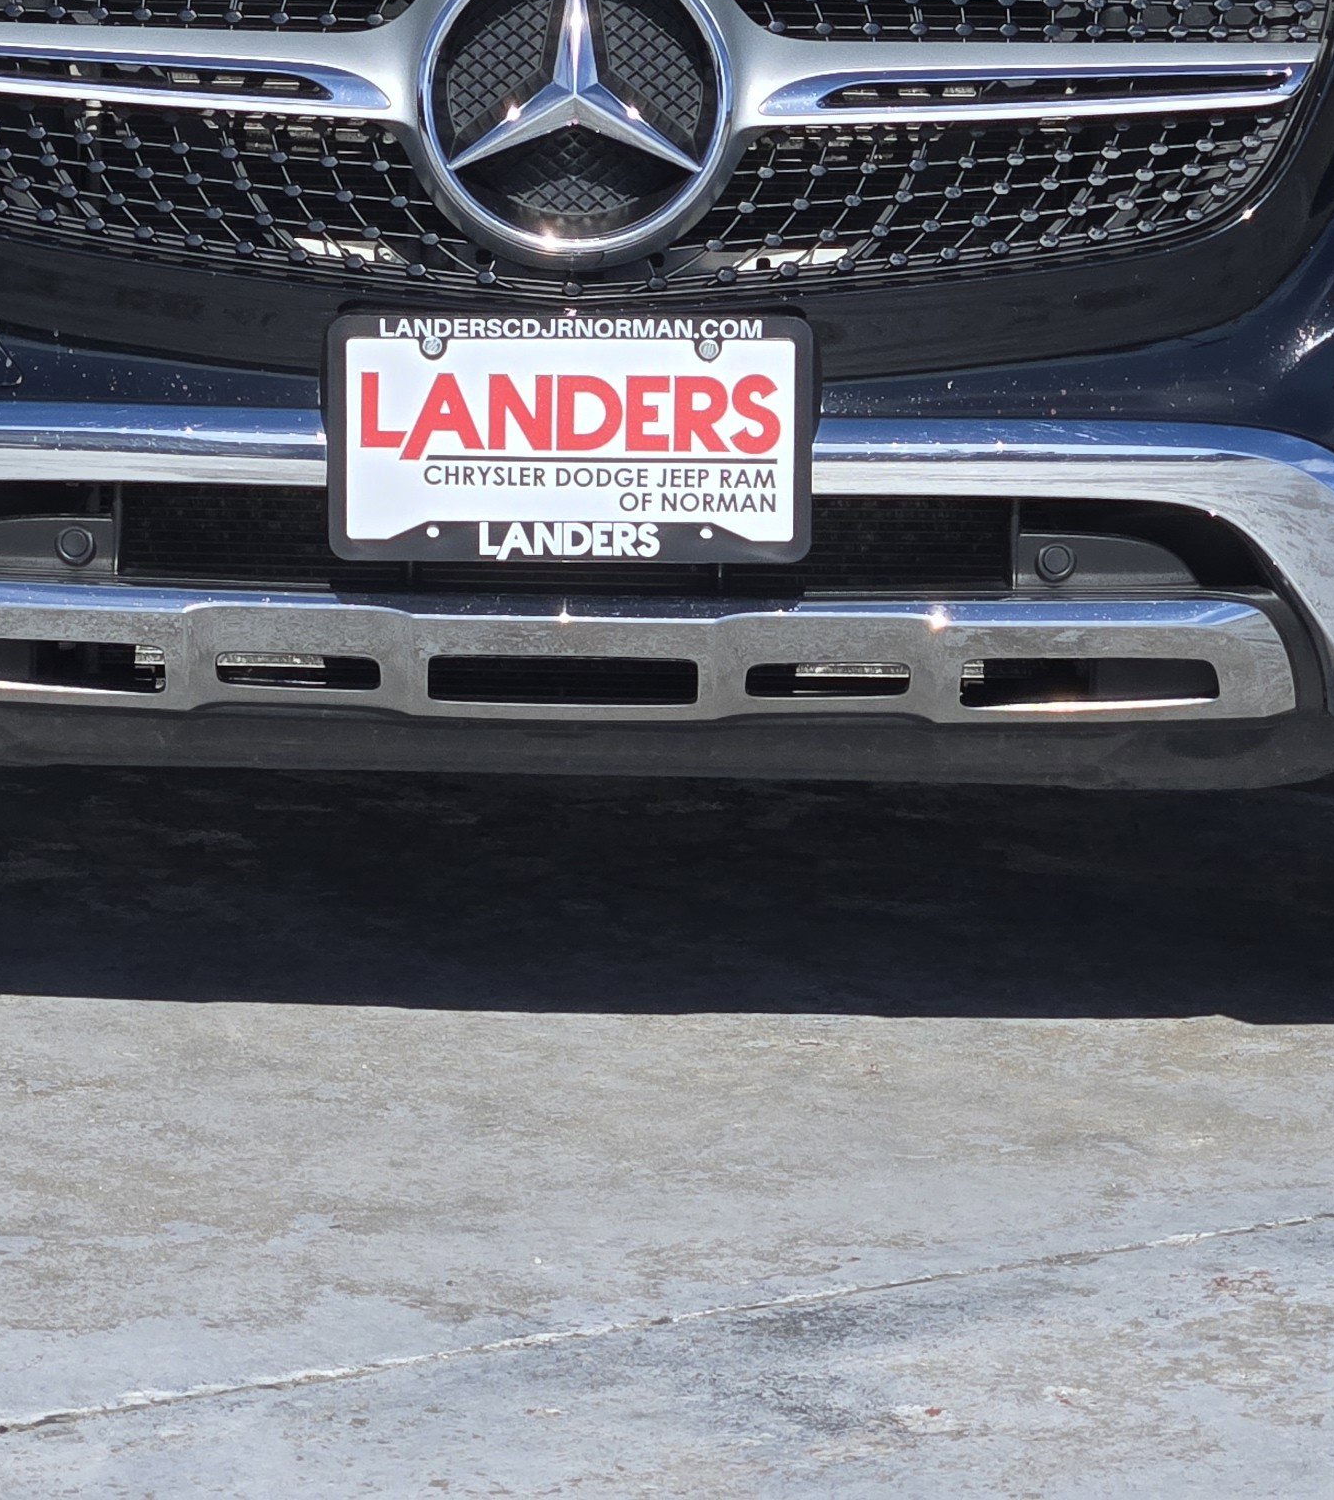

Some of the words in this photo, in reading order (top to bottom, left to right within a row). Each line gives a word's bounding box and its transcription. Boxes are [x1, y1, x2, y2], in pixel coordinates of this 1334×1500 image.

[378, 317, 764, 340] LANDERSCDJRNORMAN.COM
[360, 371, 782, 461] LANDERS
[423, 464, 547, 488] CHRYSLER
[555, 467, 649, 489] DODGE
[656, 467, 711, 489] JEEP
[720, 468, 777, 490] RAM
[618, 492, 653, 513] OF
[661, 492, 777, 514] NORMAN
[478, 521, 661, 562] LANDERS
